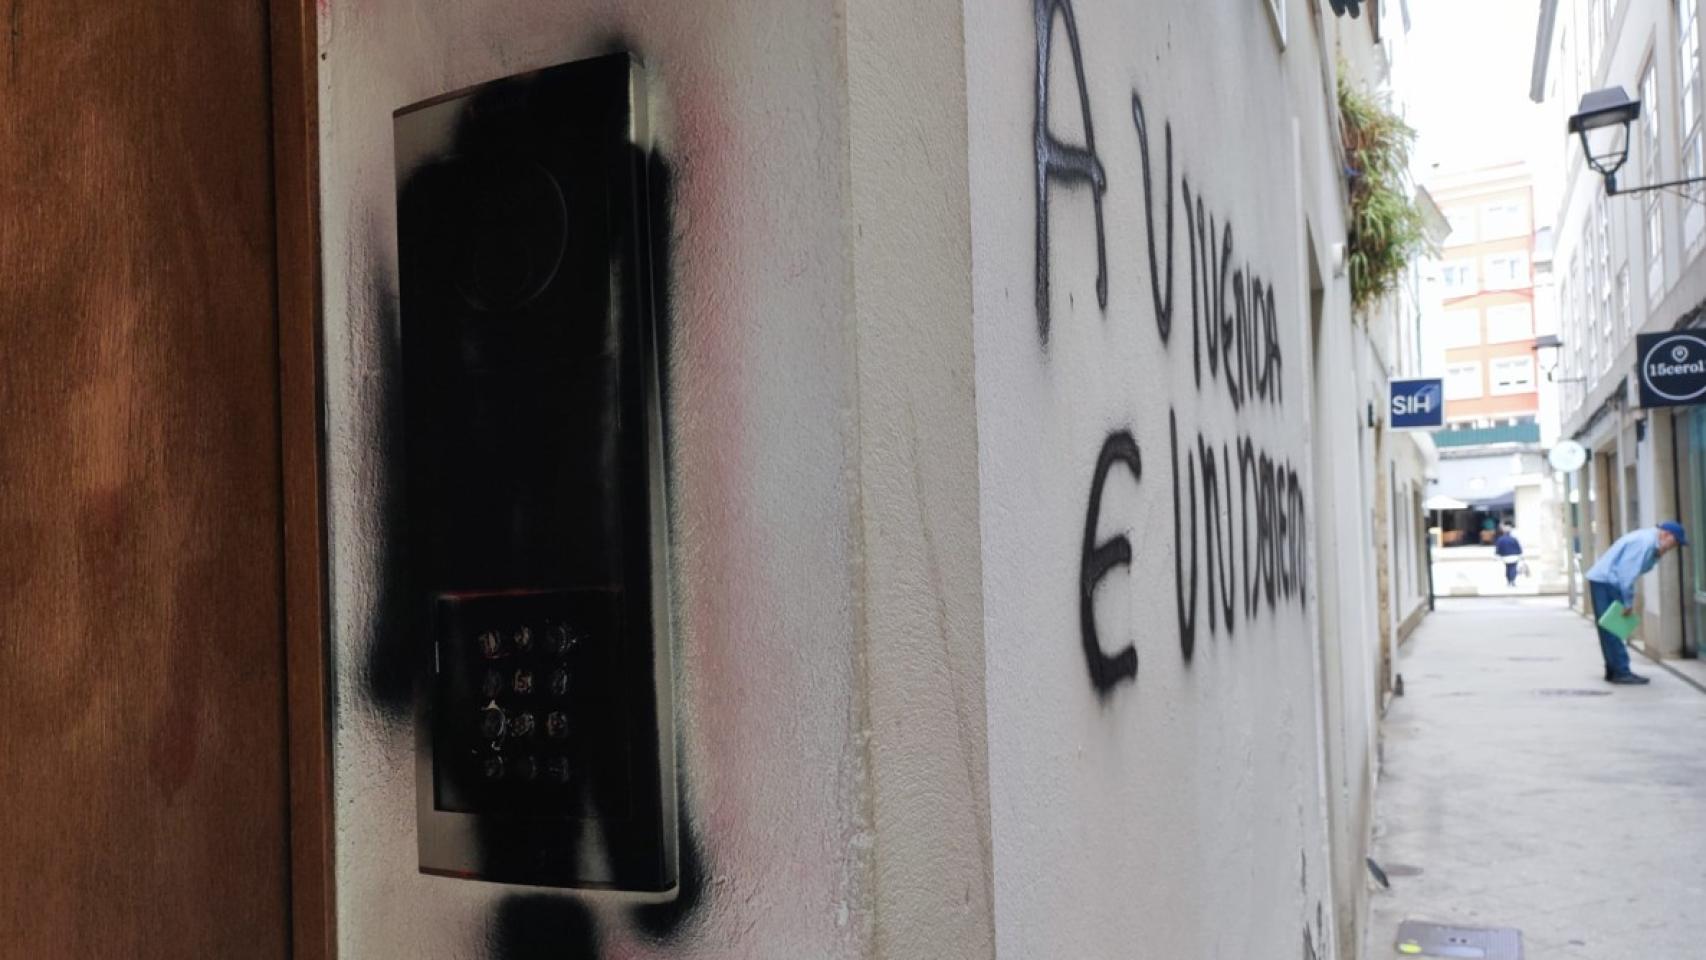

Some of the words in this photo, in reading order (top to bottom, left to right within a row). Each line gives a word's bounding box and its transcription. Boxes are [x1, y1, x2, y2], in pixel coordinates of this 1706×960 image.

[1035, 0, 1107, 347] A
[1131, 90, 1283, 412] VIVENDA
[1392, 394, 1431, 415] SIH
[1080, 428, 1142, 700] E
